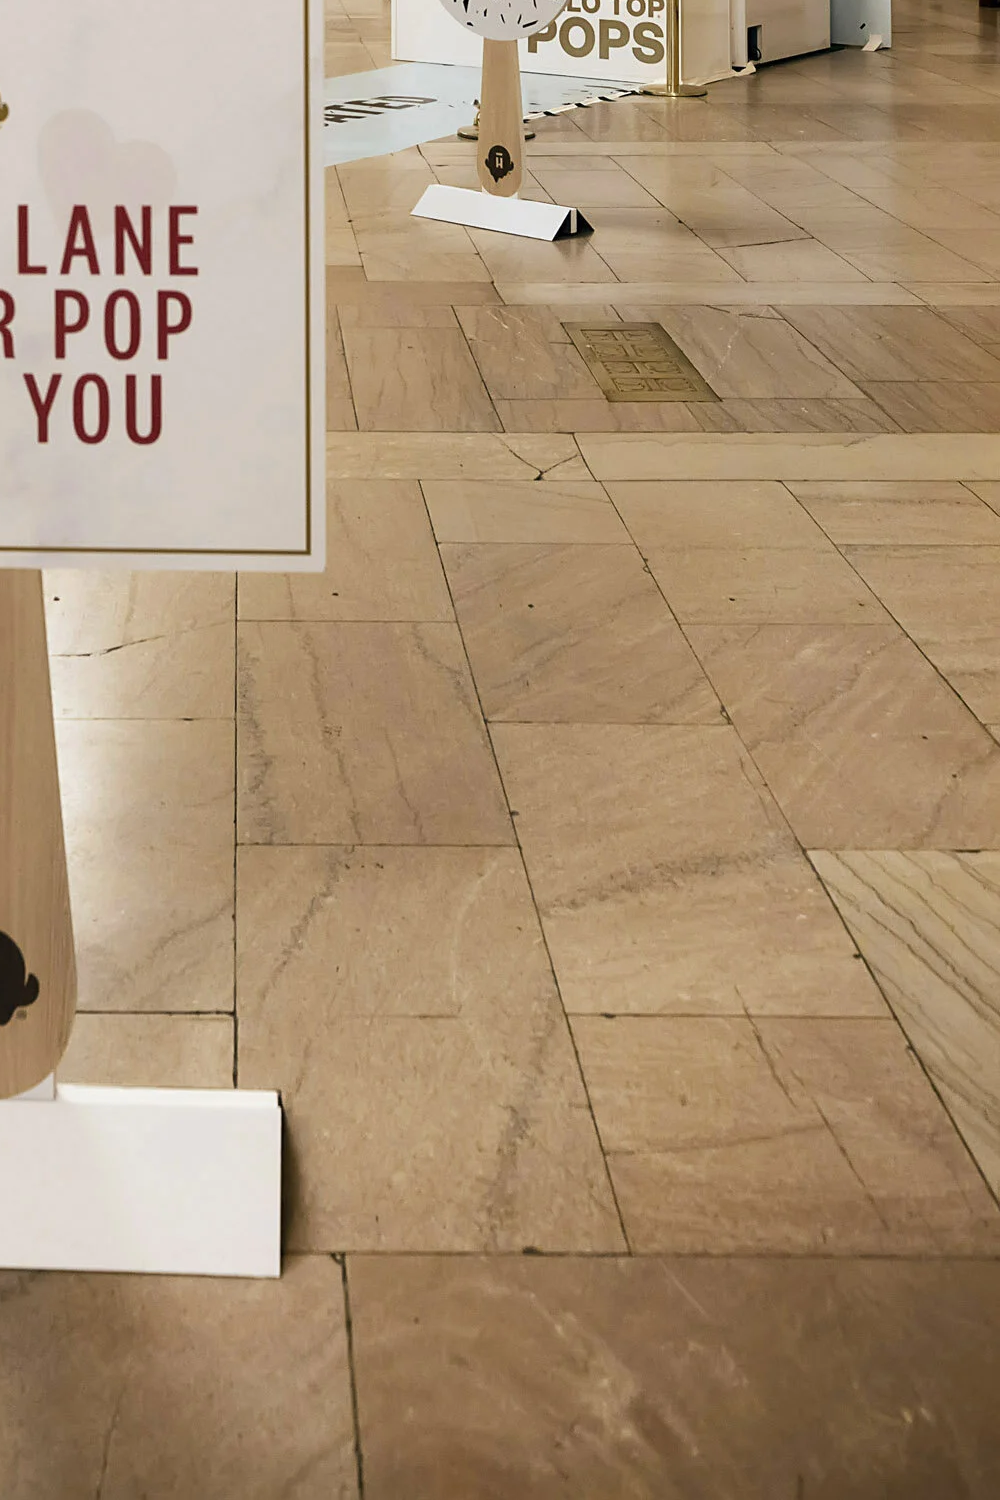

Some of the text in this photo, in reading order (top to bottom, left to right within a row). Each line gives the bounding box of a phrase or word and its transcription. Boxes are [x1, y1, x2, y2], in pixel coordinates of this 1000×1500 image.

[528, 16, 664, 64] POPS
[17, 204, 200, 276] LANE
[54, 289, 193, 361] POP
[23, 373, 163, 446] YOU
